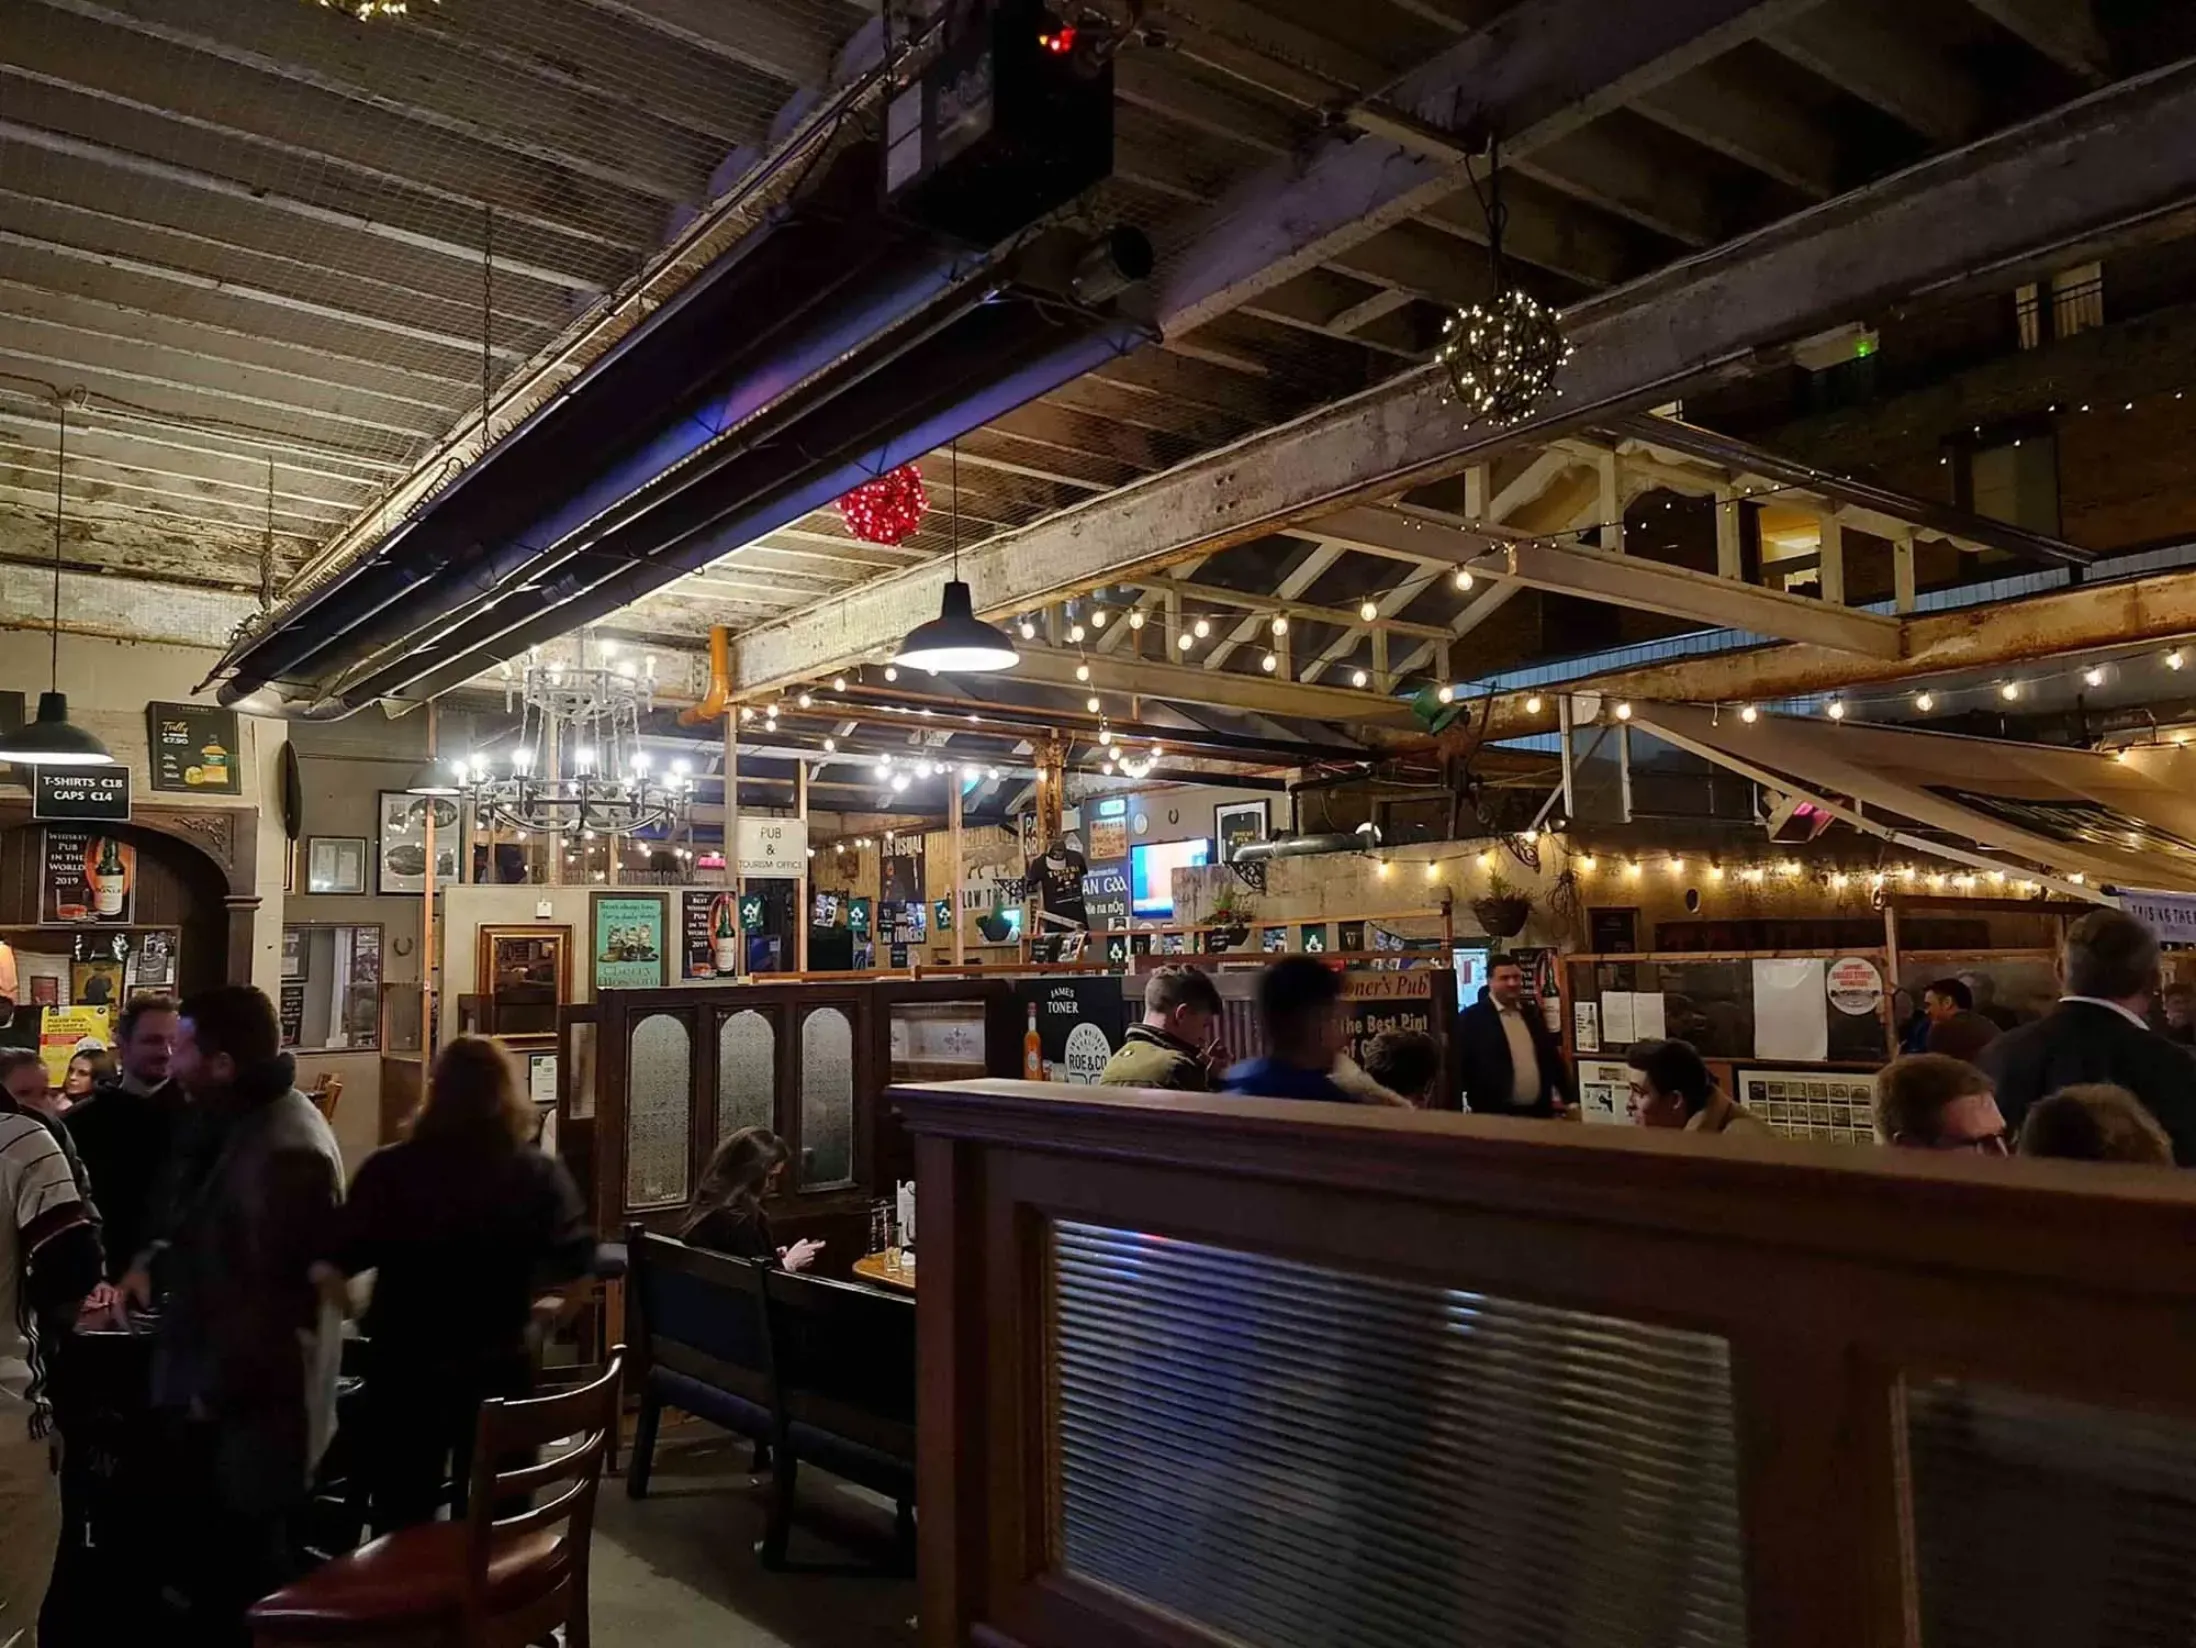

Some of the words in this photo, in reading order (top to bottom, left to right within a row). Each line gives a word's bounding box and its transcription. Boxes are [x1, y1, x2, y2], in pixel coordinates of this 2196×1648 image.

[43, 776, 96, 788] T-SHIRTS
[100, 778, 124, 789] €18
[54, 790, 85, 801] CAPS
[90, 791, 113, 802] €14
[48, 832, 88, 841] WHISKEY
[760, 826, 782, 839] PUB
[58, 842, 79, 851] PUB
[766, 843, 775, 856] &
[882, 840, 894, 858] AS
[894, 834, 923, 858] USUAL
[51, 853, 63, 861] IN
[65, 853, 85, 861] THE
[48, 863, 88, 871] WORLD
[739, 860, 774, 870] TOURISM
[776, 860, 803, 870] OFFICE
[55, 876, 79, 886] 2019
[1343, 974, 1392, 997] oner's
[1050, 987, 1075, 999] JAMES
[1047, 1001, 1079, 1014] TONER
[1367, 1014, 1397, 1033] Best
[1400, 1013, 1428, 1031] Pint
[1068, 1054, 1108, 1071] ROE&CO
